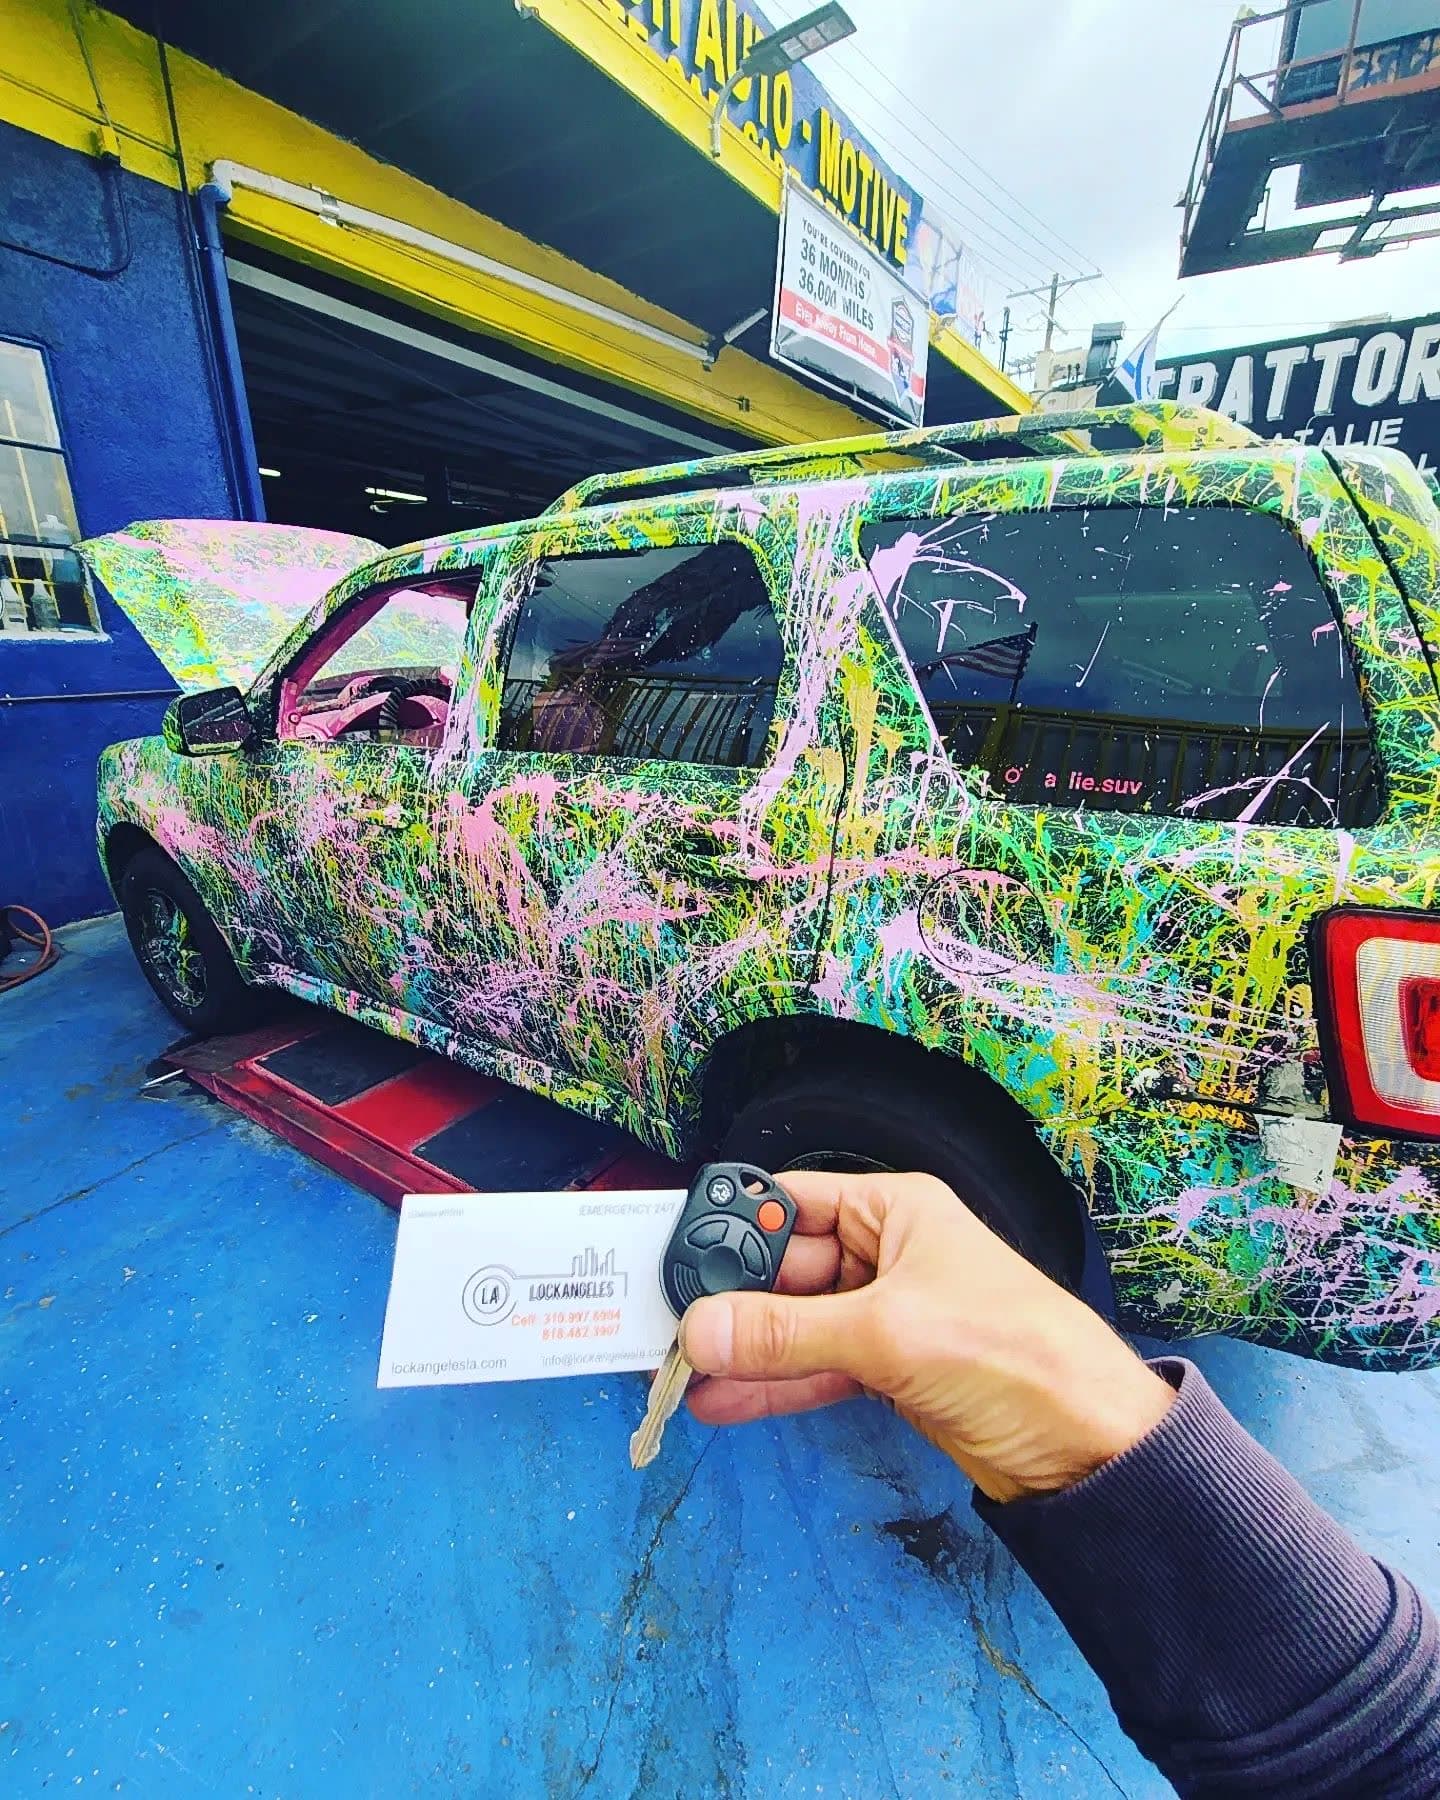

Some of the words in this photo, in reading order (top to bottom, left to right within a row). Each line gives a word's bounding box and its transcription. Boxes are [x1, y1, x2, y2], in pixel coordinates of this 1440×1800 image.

[819, 106, 911, 267] MOTIVE
[800, 238, 816, 266] 36
[819, 251, 865, 300] MONTHS
[802, 217, 828, 248] YOU'RE
[830, 241, 859, 272] COVERED
[798, 267, 837, 309] 36,000
[842, 296, 875, 332] MILES
[481, 1285, 500, 1305] LA
[528, 1281, 615, 1302] LOCKANGELES
[391, 1356, 507, 1375] lockangelesla.com
